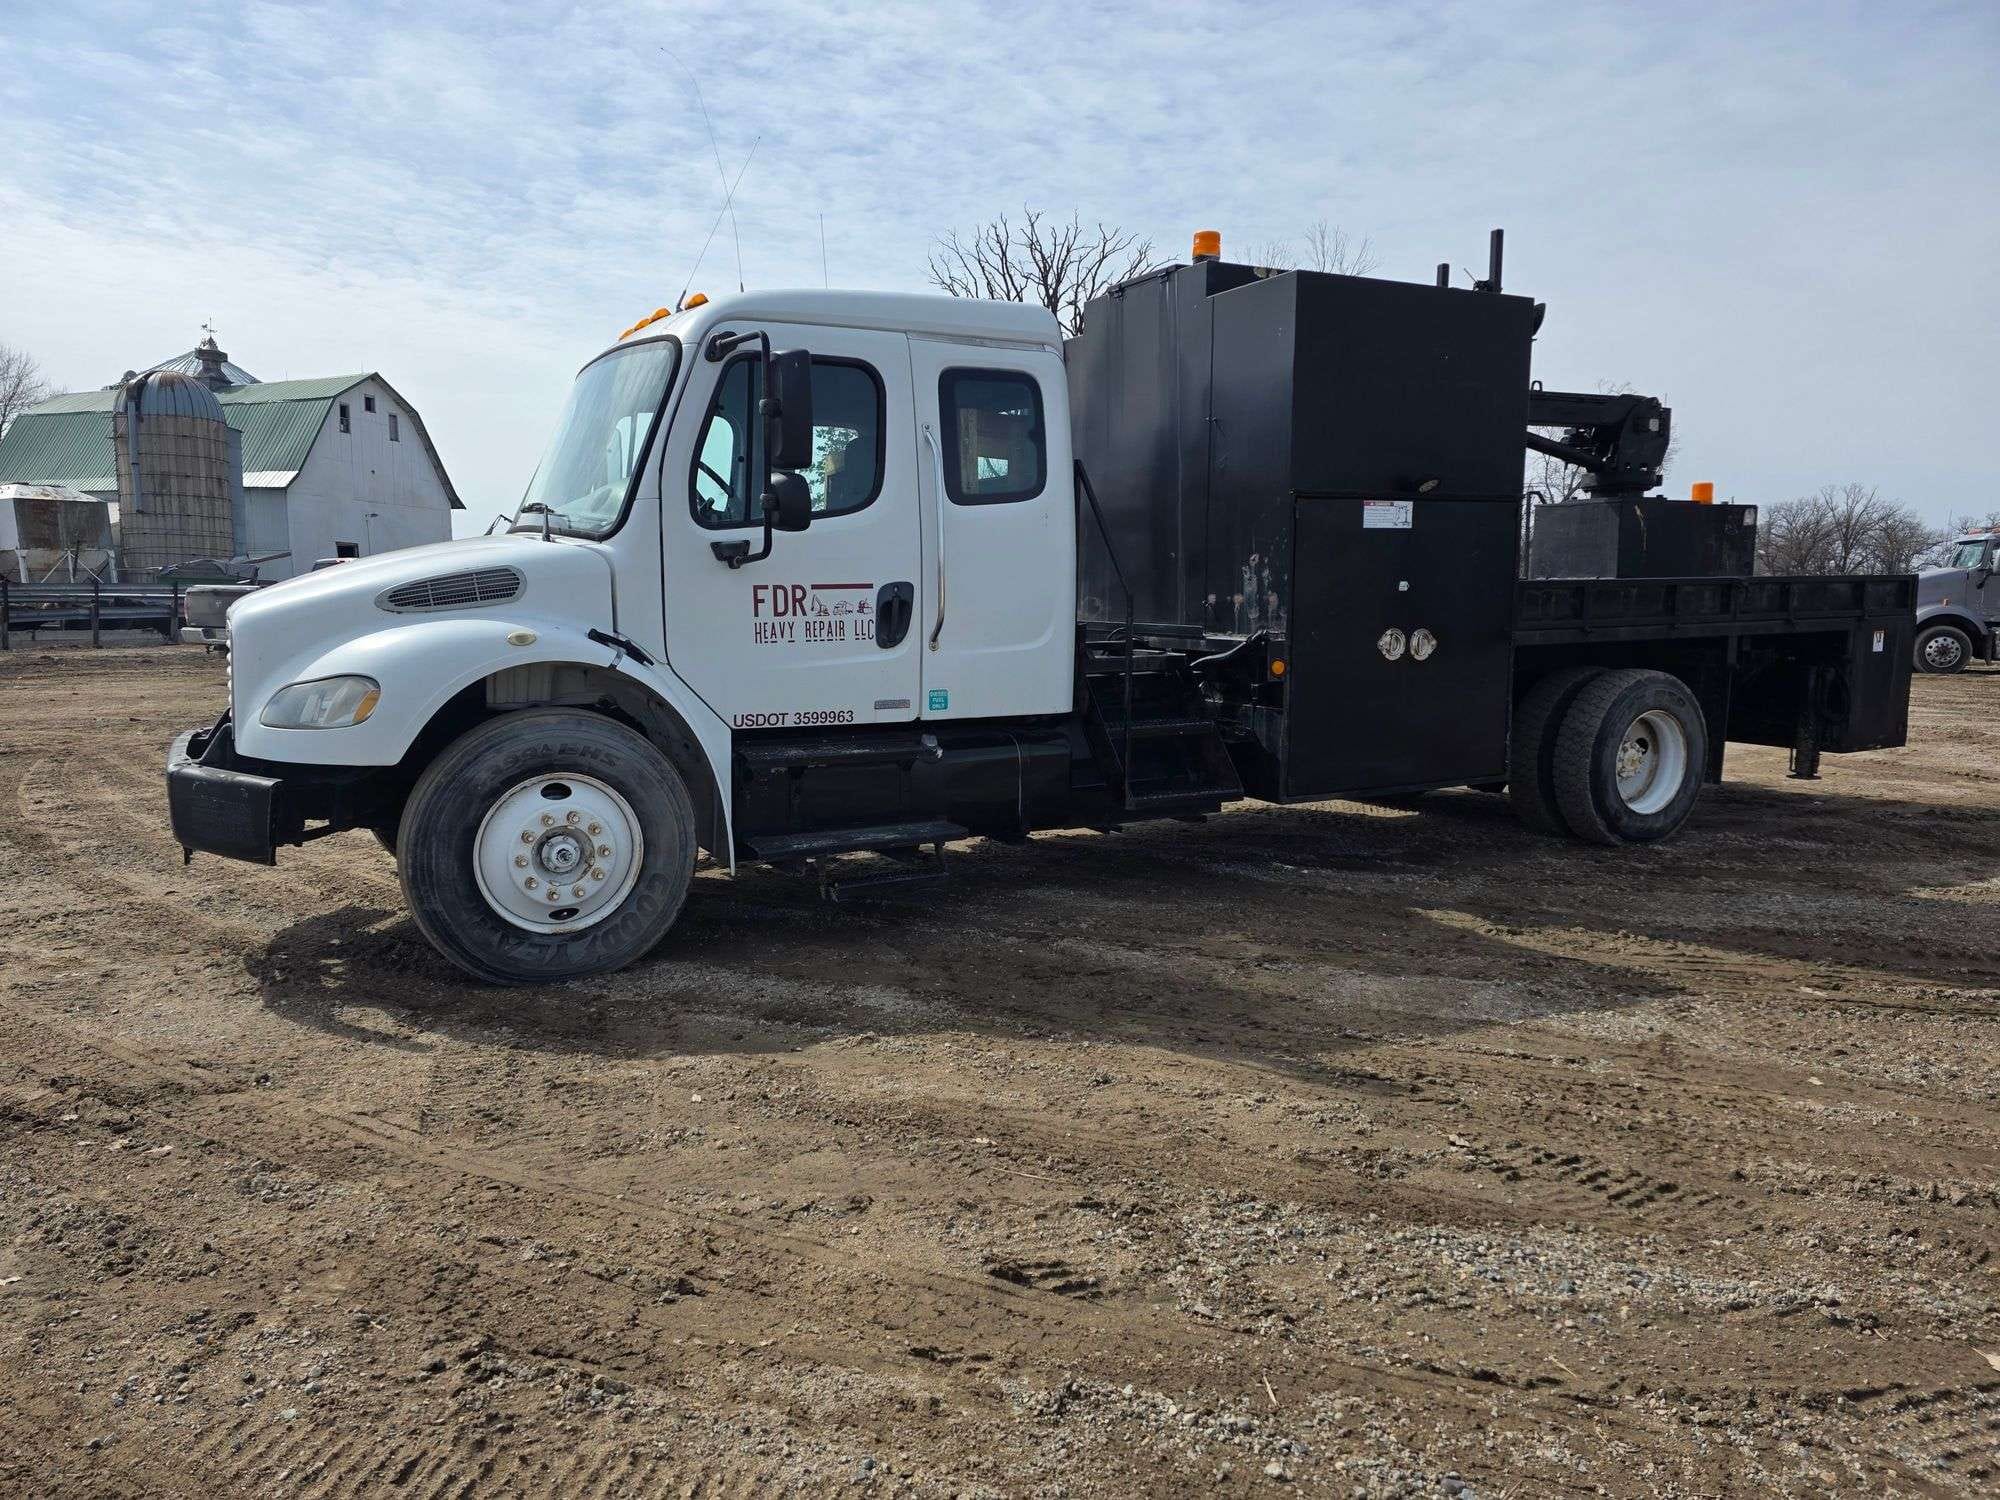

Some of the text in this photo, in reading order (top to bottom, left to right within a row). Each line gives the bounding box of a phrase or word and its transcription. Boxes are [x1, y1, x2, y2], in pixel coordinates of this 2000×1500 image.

[752, 584, 808, 617] FDR
[754, 619, 875, 644] HEAVY REPAIR LLC
[733, 710, 854, 728] USDOT 3599963
